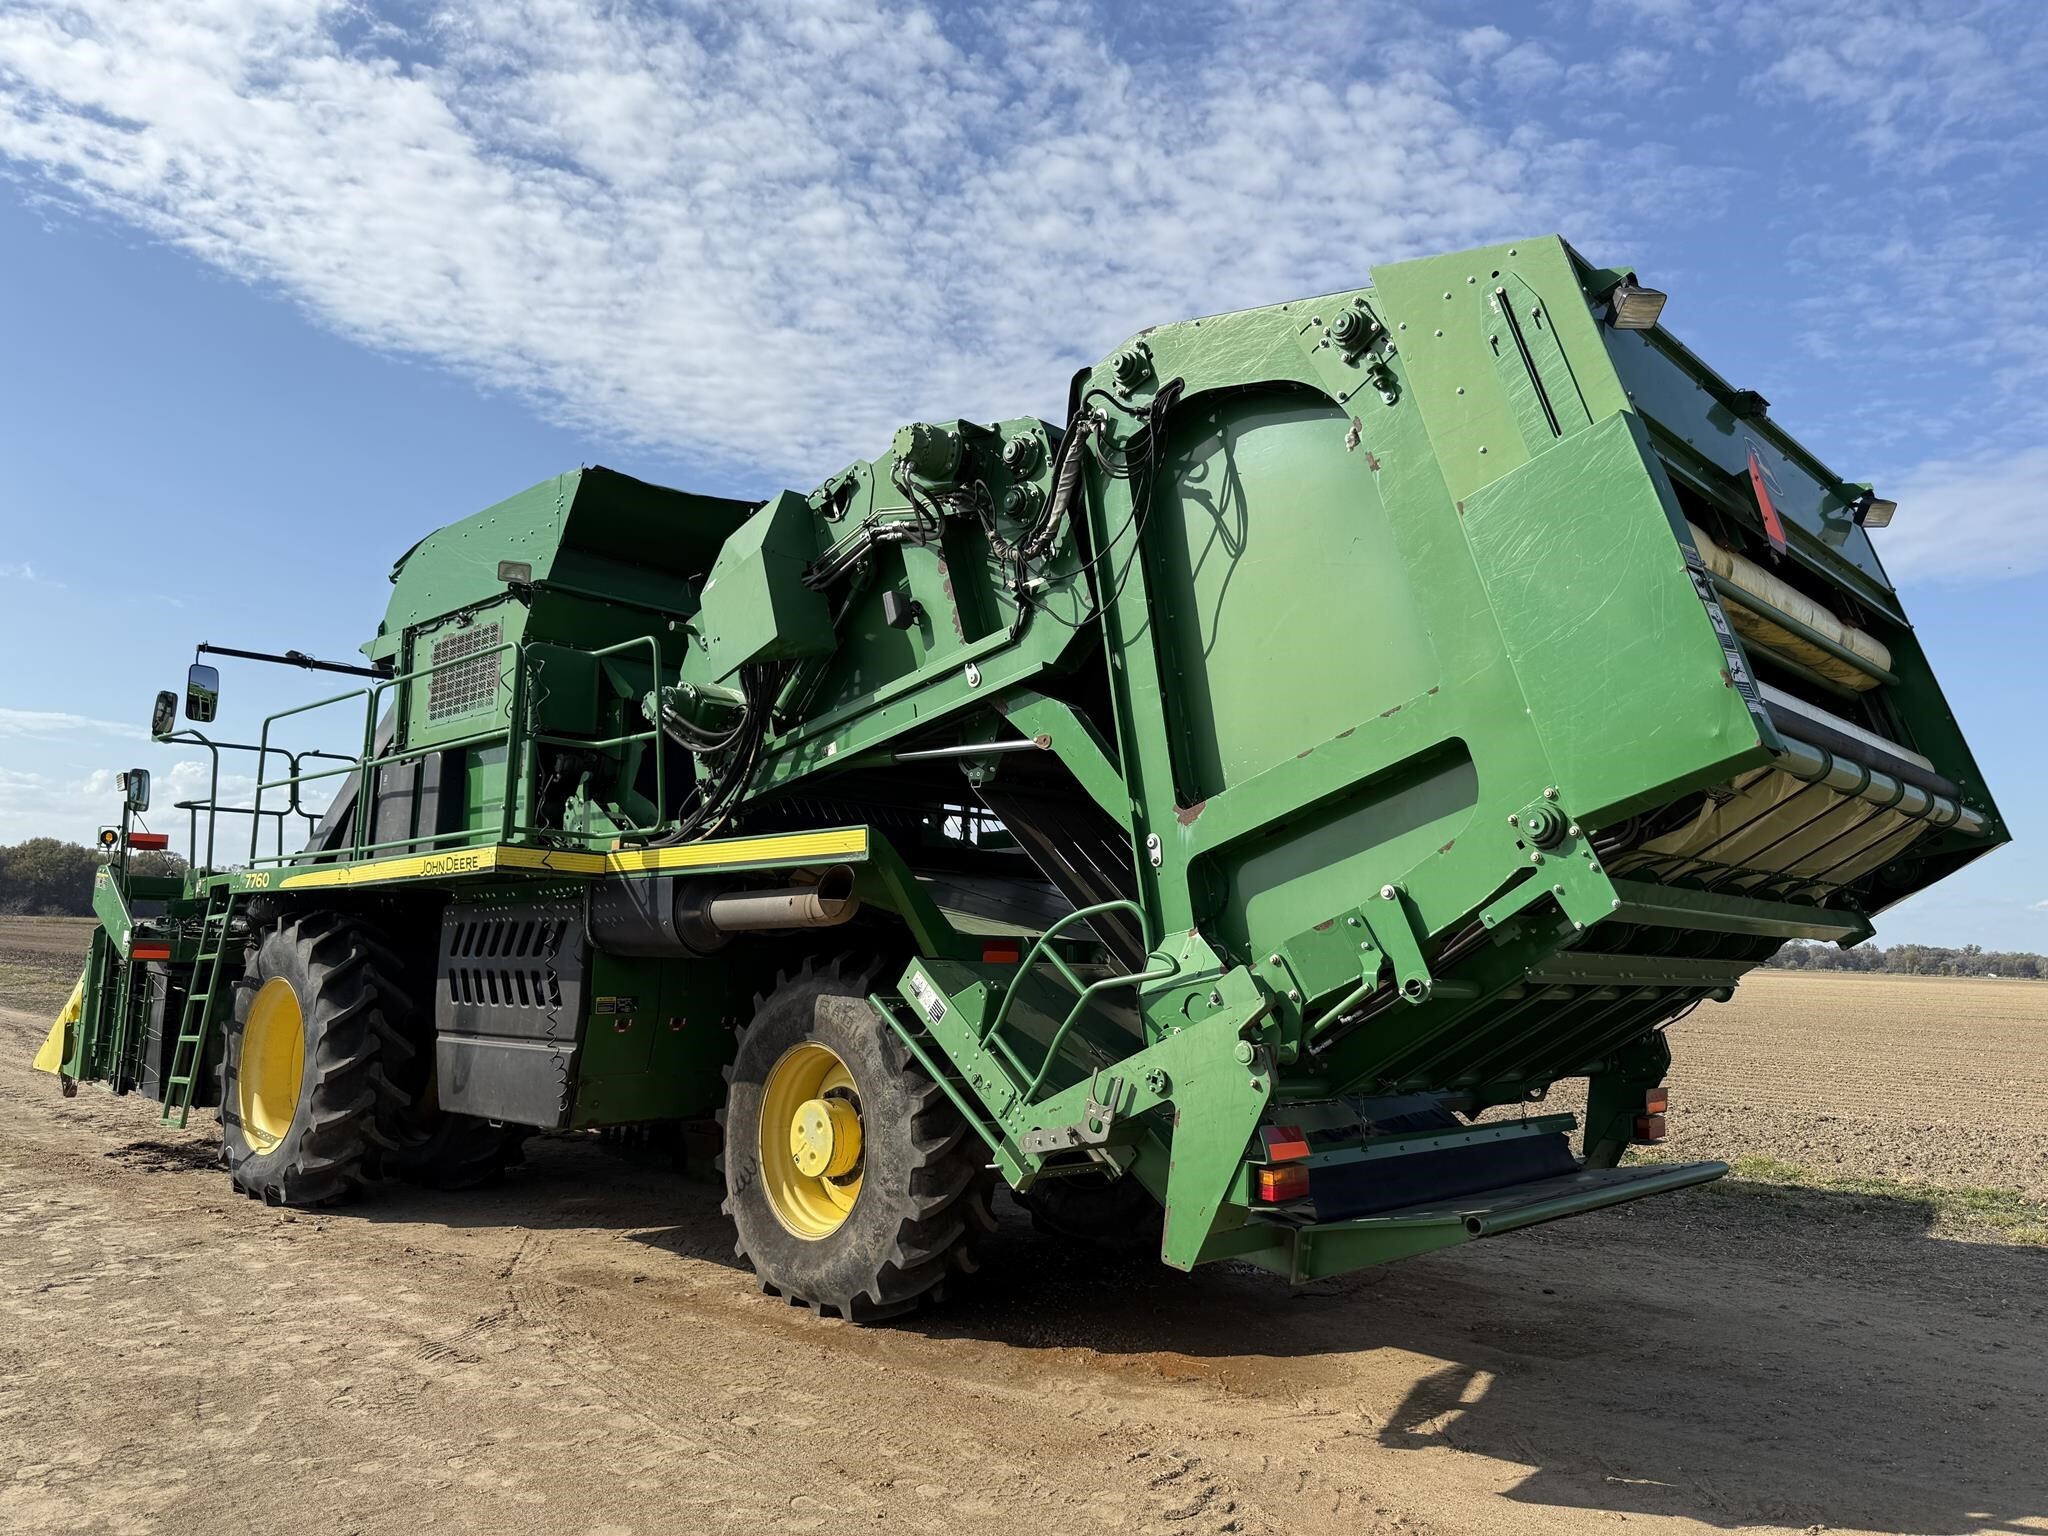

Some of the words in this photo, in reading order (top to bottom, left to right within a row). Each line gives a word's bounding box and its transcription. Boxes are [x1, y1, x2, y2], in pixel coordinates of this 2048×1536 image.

[420, 859, 445, 875] JOHN
[446, 856, 479, 872] DEERE
[245, 872, 270, 889] 7760
